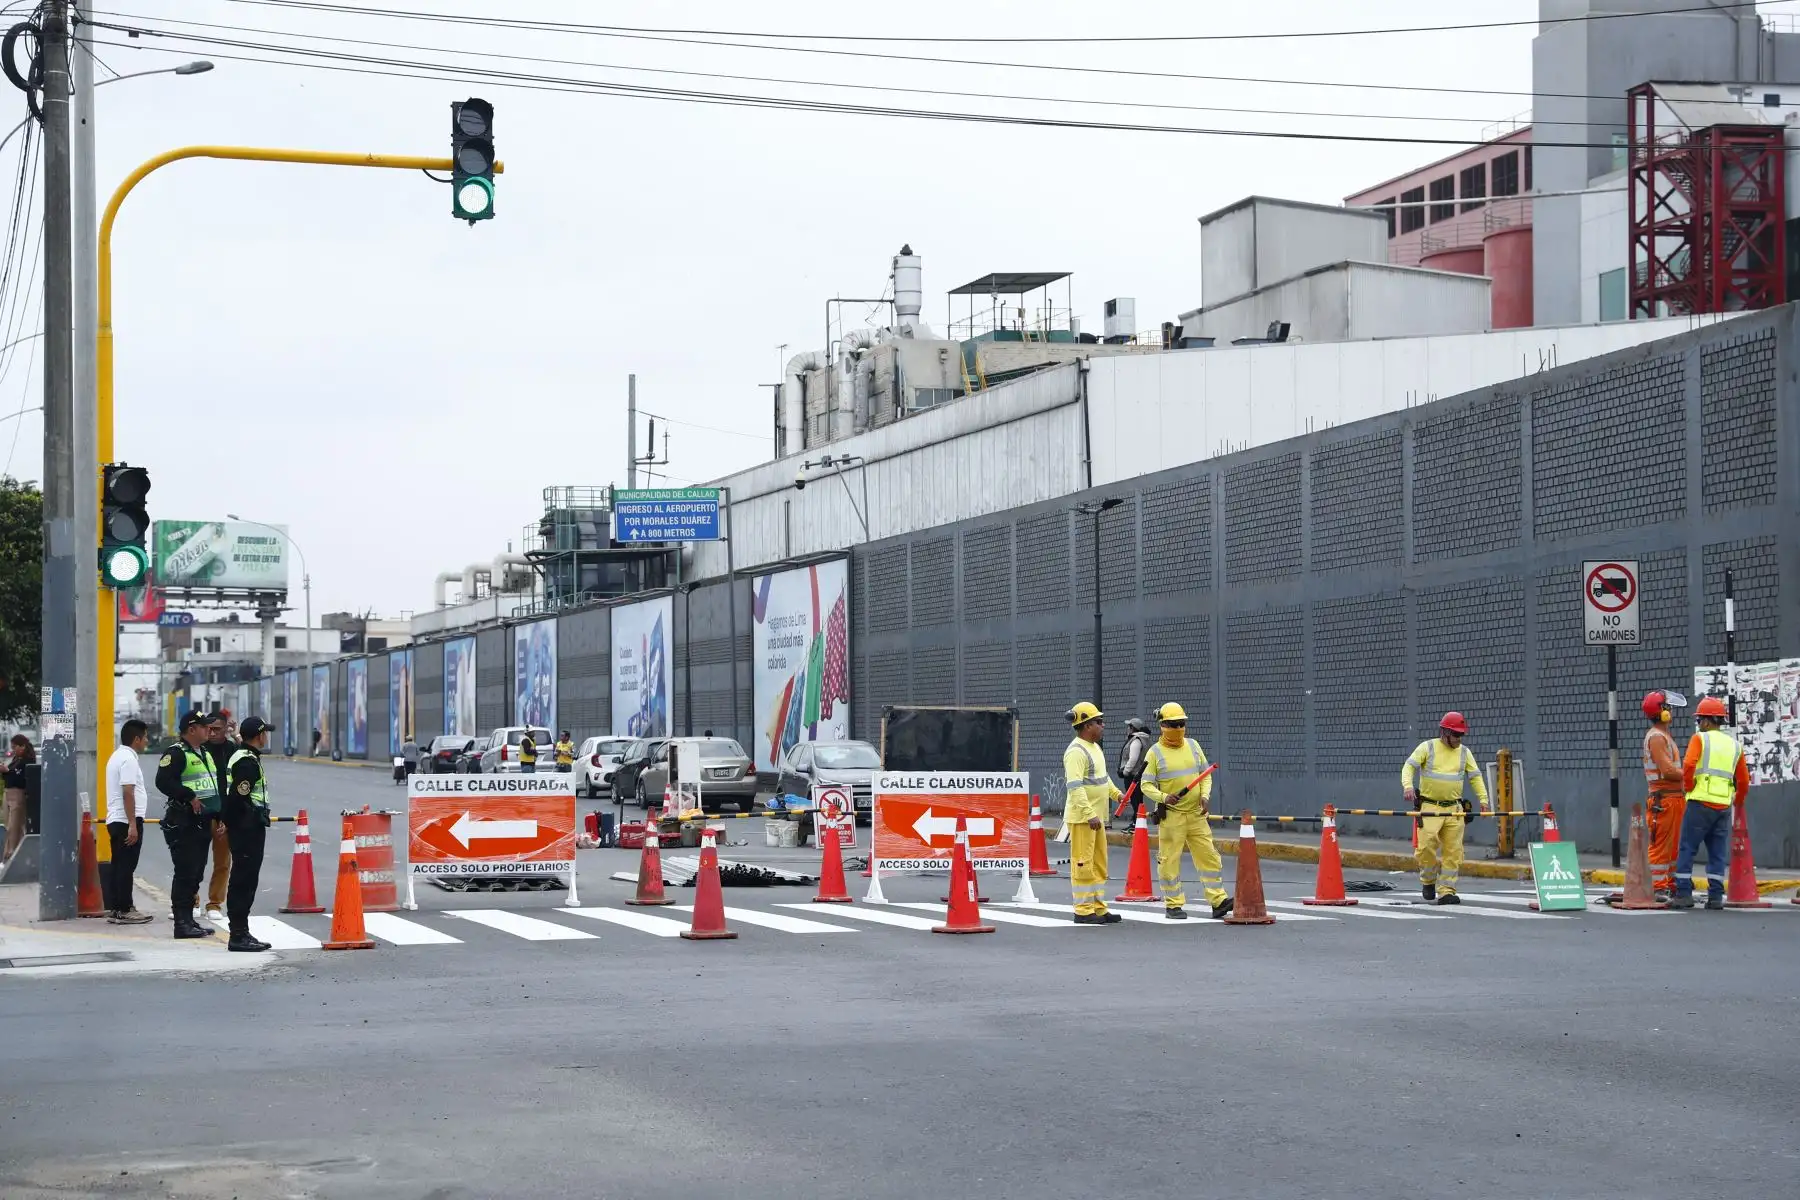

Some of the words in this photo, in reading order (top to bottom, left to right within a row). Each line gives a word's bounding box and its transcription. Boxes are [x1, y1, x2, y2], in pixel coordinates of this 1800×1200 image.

[618, 490, 671, 500] MUNICIPALIDAD
[672, 490, 686, 498] DEL
[688, 490, 715, 498] CALLAO
[618, 504, 652, 514] INGRESO
[654, 504, 664, 513] AL
[666, 504, 716, 512] AEROPUERTO
[624, 517, 641, 526] POR
[642, 516, 678, 526] MORALES
[648, 530, 662, 538] 800
[664, 528, 696, 537] METROS
[159, 615, 182, 625] JMT
[795, 611, 806, 626] Lima
[1602, 616, 1621, 626] NO
[768, 638, 776, 650] una
[777, 632, 792, 648] ciudad
[793, 630, 804, 647] más
[1588, 630, 1636, 641] CAMIONES
[768, 654, 786, 670] colorida
[414, 780, 463, 792] CALLE
[468, 780, 570, 792] CLAUSURADA
[880, 778, 925, 789] CALLE
[928, 778, 1024, 789] CLAUSURADA
[414, 864, 458, 873] ACCESO
[460, 864, 490, 873] SOLO
[492, 862, 570, 872] PROPIETARIOS
[879, 860, 920, 869] ACCESO
[922, 860, 950, 868] SOLO
[974, 860, 1024, 868] PIETARIOS
